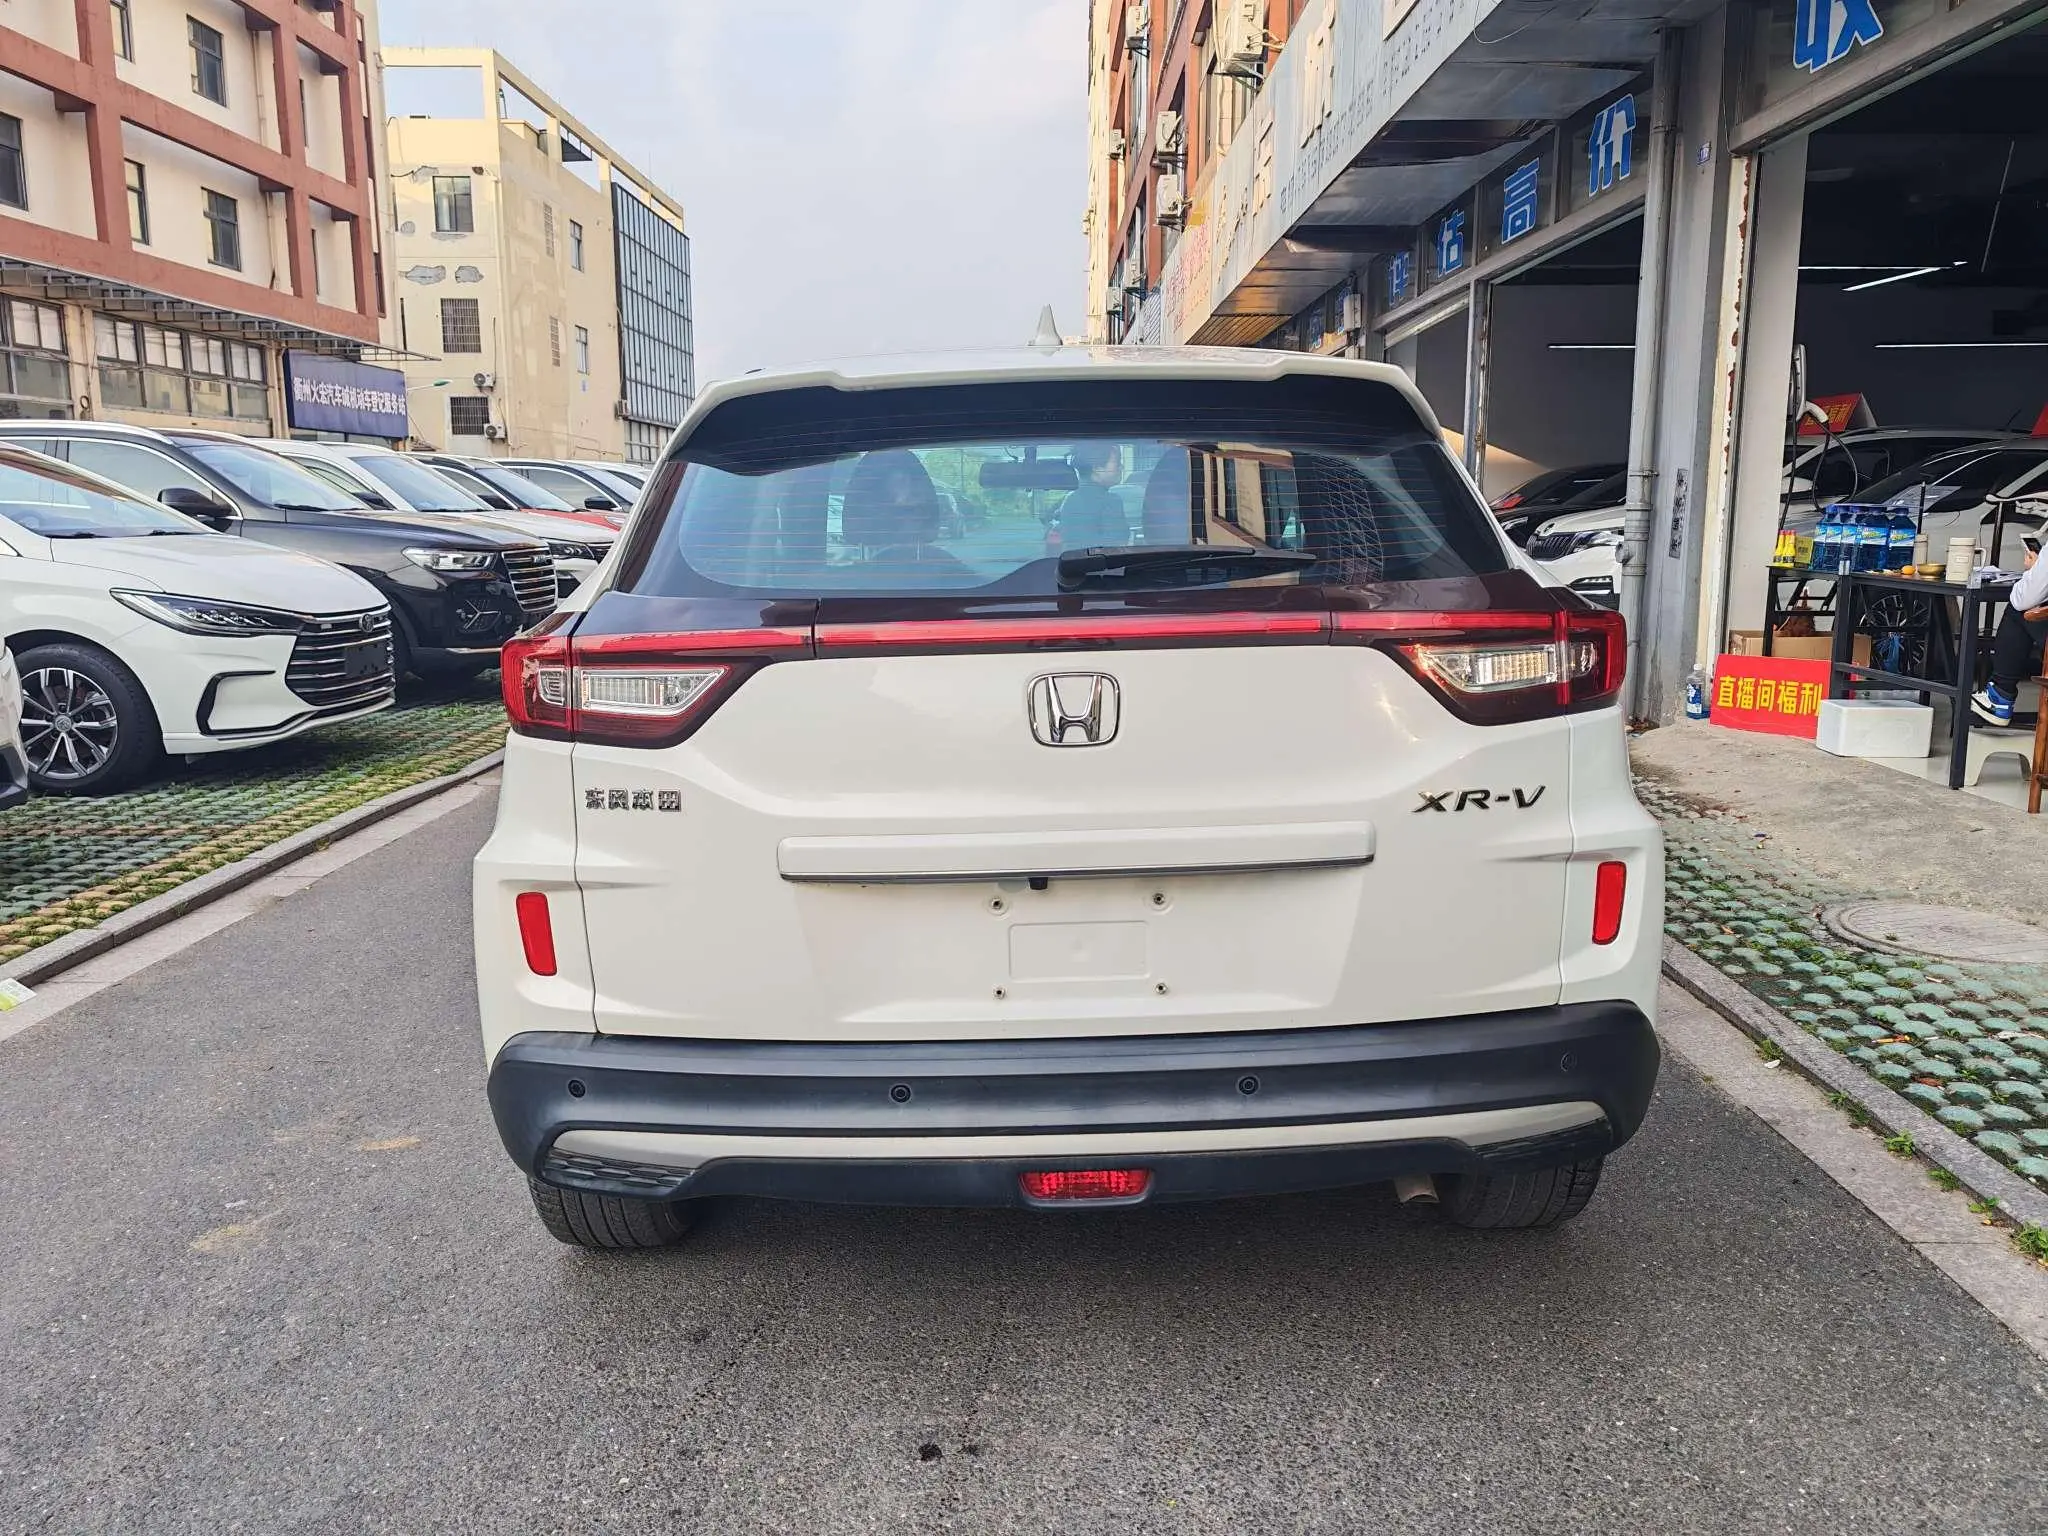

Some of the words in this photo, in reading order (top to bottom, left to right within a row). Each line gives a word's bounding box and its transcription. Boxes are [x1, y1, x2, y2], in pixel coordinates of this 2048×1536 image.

[1717, 675, 1823, 717] 直播间福利
[584, 787, 682, 812] 东风本田
[1411, 785, 1546, 813] XR-V
